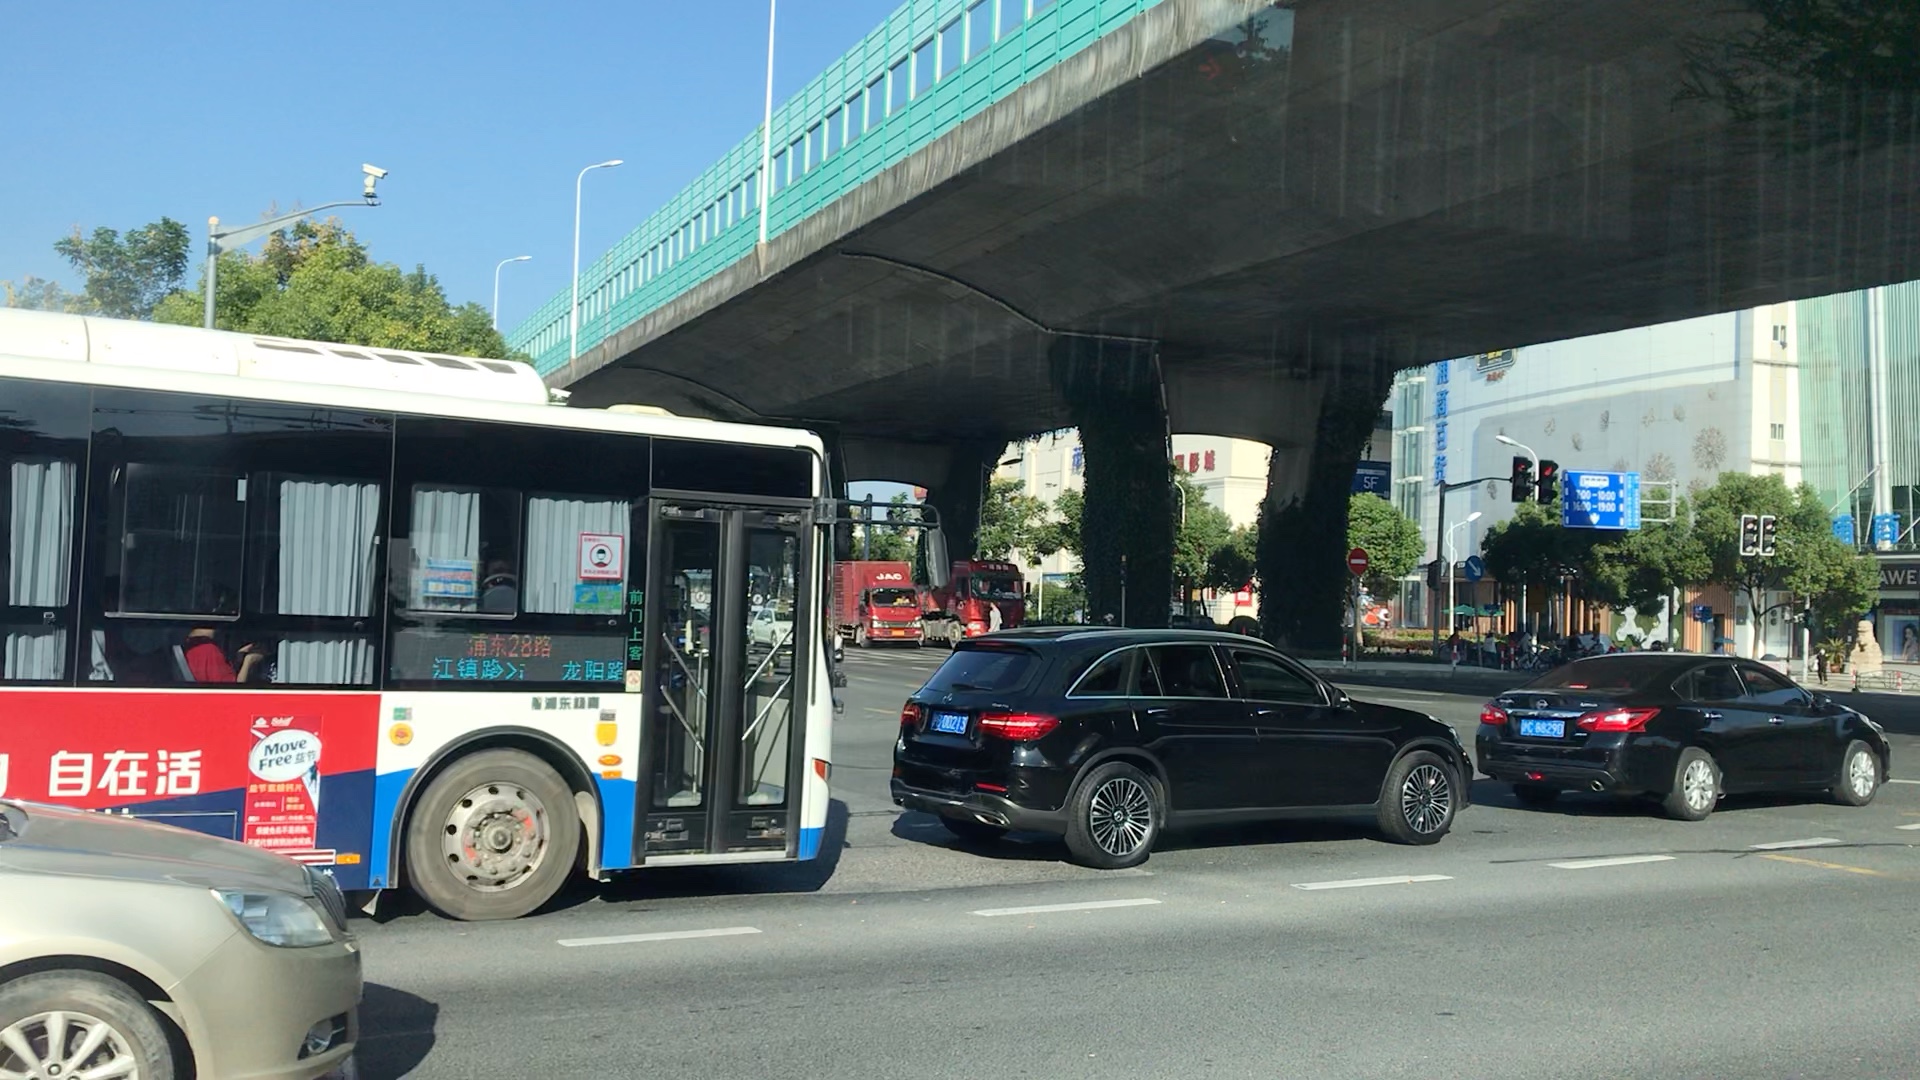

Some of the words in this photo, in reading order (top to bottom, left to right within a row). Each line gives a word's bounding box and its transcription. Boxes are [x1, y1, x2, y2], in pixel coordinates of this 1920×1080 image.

[1363, 476, 1379, 490] 5F
[876, 573, 903, 581] JAC
[1880, 569, 1920, 585] AWE
[629, 589, 643, 661] 前门上客
[467, 634, 552, 658] 浦东28路
[263, 739, 308, 757] Move
[259, 754, 293, 771] Free
[48, 749, 203, 798] 自在活
